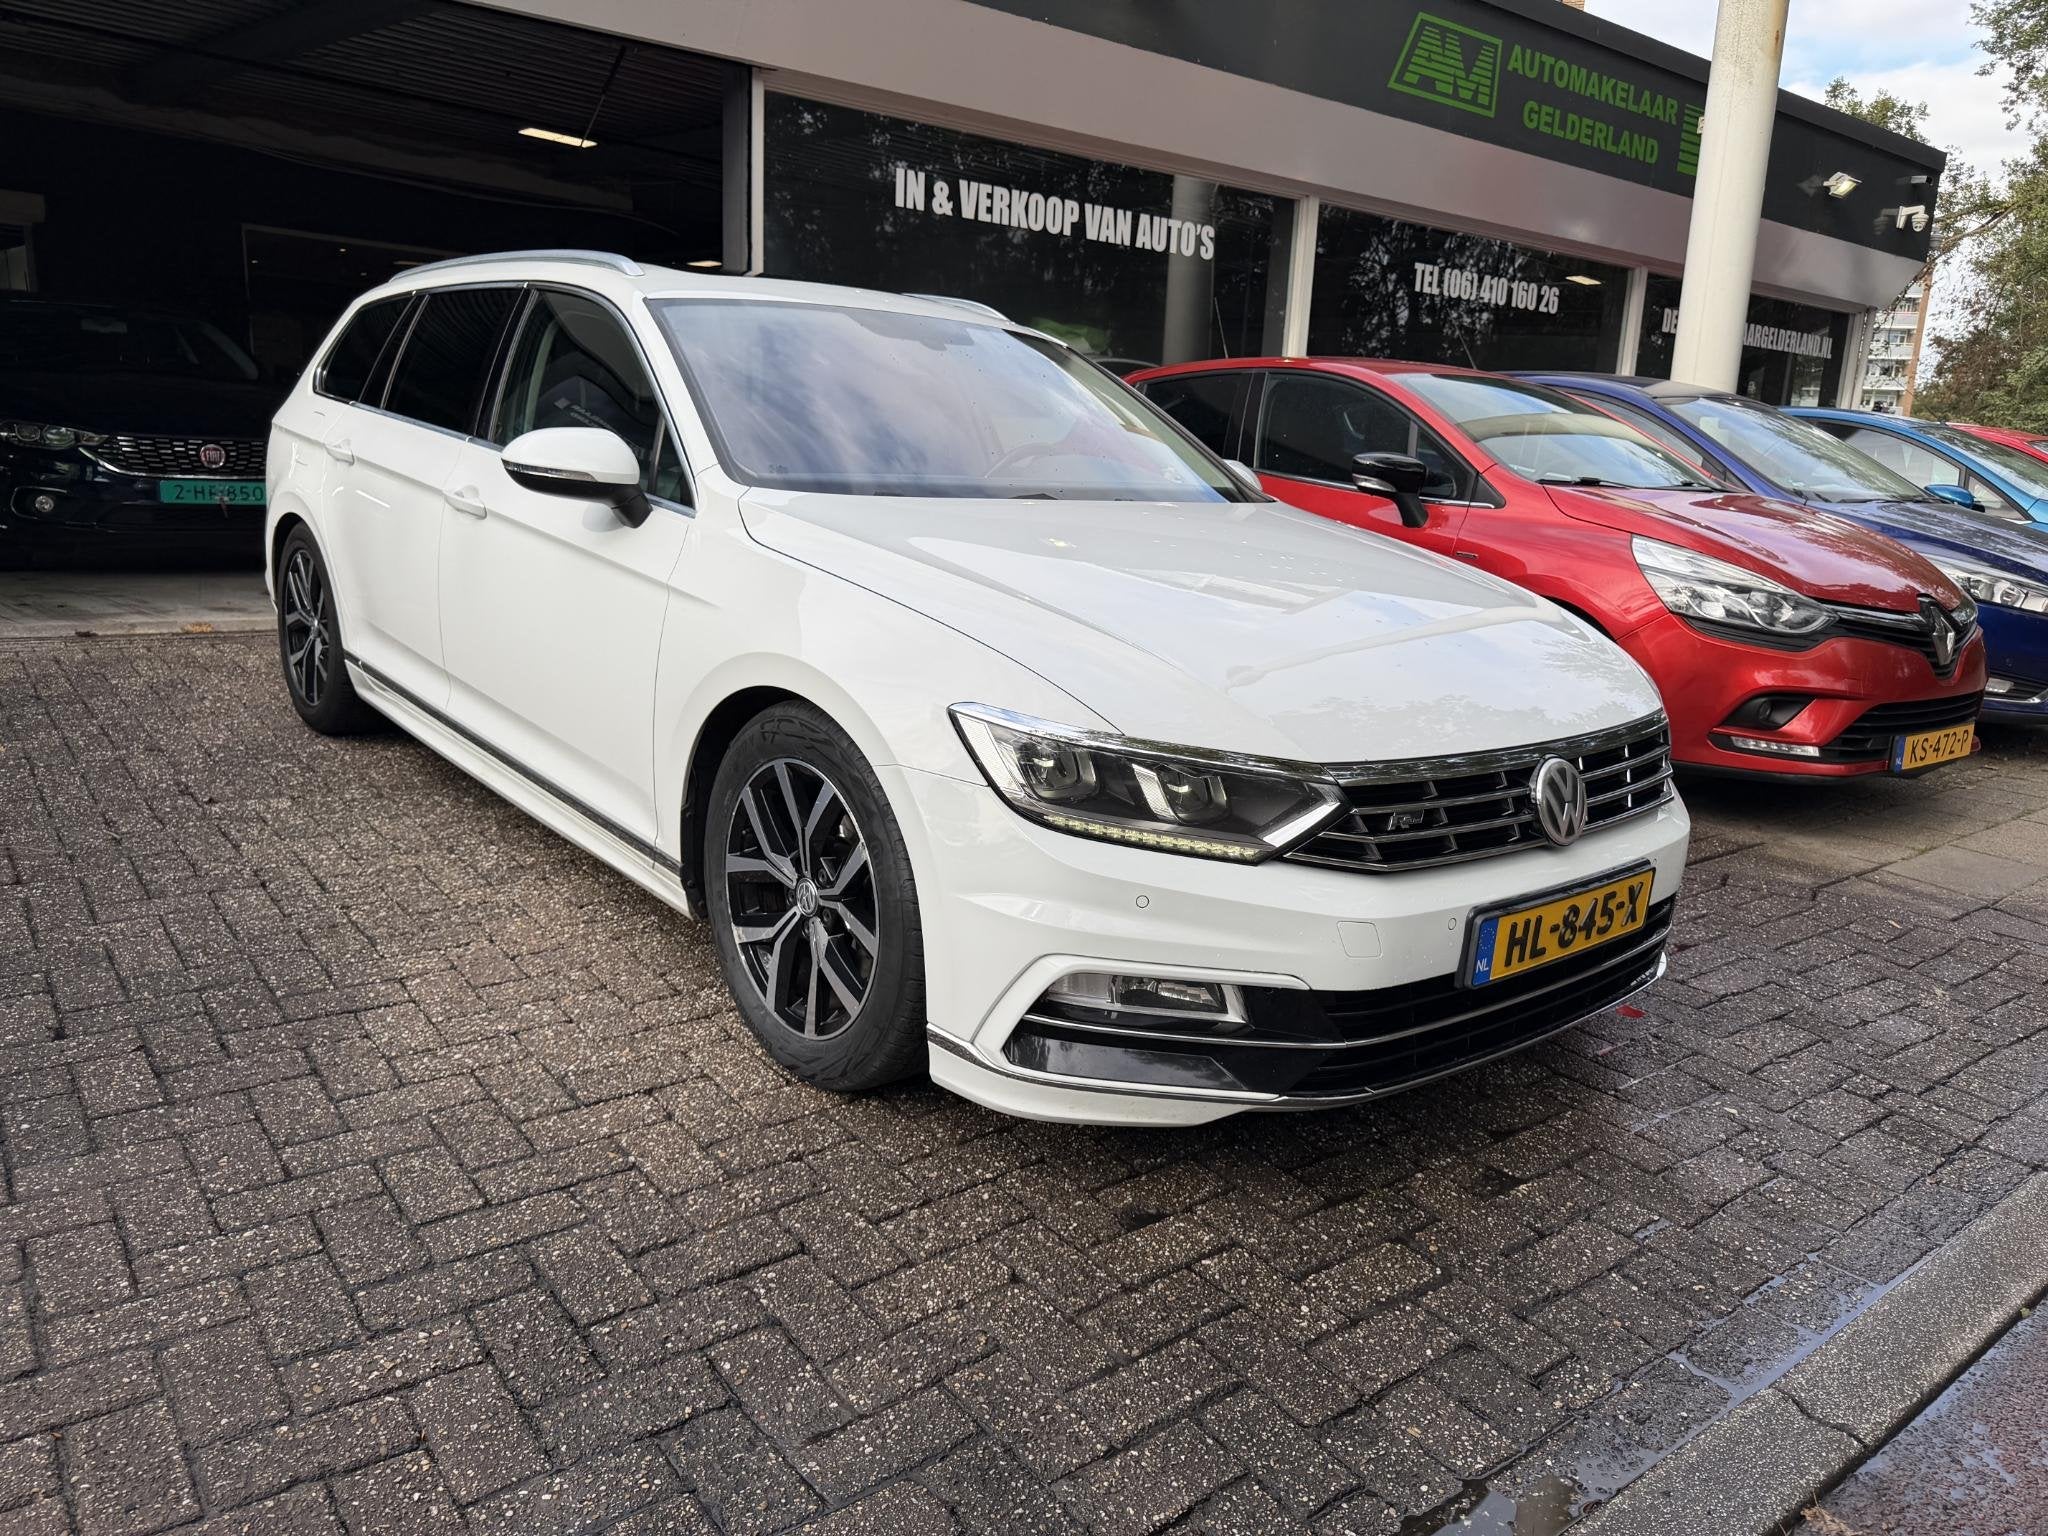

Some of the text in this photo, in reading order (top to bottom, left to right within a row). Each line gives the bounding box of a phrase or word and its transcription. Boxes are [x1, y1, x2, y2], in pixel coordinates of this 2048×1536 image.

[1507, 43, 1680, 126] AUTOMAKELAAR
[1522, 100, 1660, 165] GELDERLAND
[894, 167, 1216, 261] IN & VERKOOP VAN AUTO'S
[1414, 261, 1560, 315] TEL (06) 410 160 26
[1909, 729, 1969, 764] KS-472-P
[1504, 881, 1644, 968] HL-845-X
[1475, 958, 1490, 974] NL
